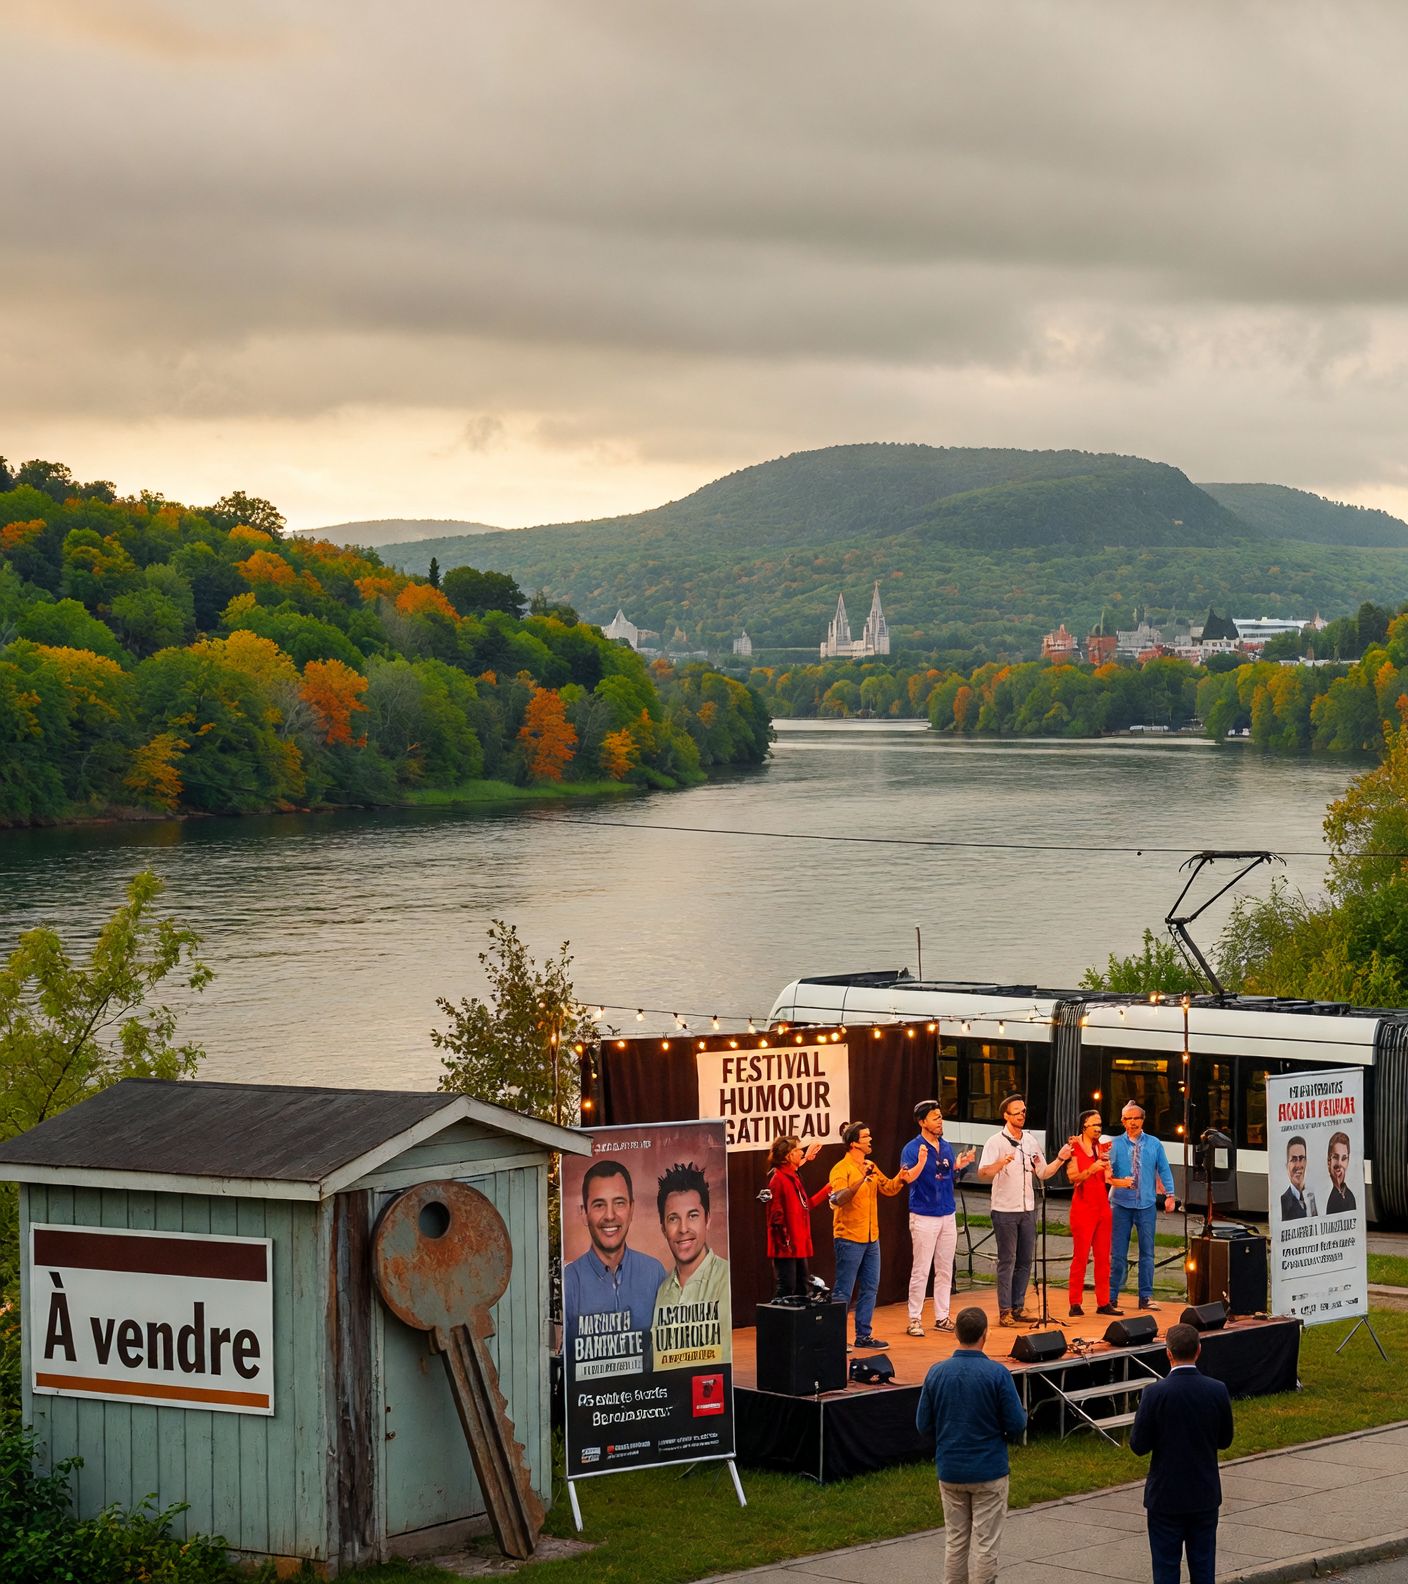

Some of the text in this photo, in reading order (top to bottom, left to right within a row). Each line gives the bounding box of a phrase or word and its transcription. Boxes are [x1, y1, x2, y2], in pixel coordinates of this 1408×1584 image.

[722, 1051, 826, 1084] FESTIVAL
[719, 1081, 831, 1117] HUMOUR
[44, 1271, 261, 1380] À vendre
